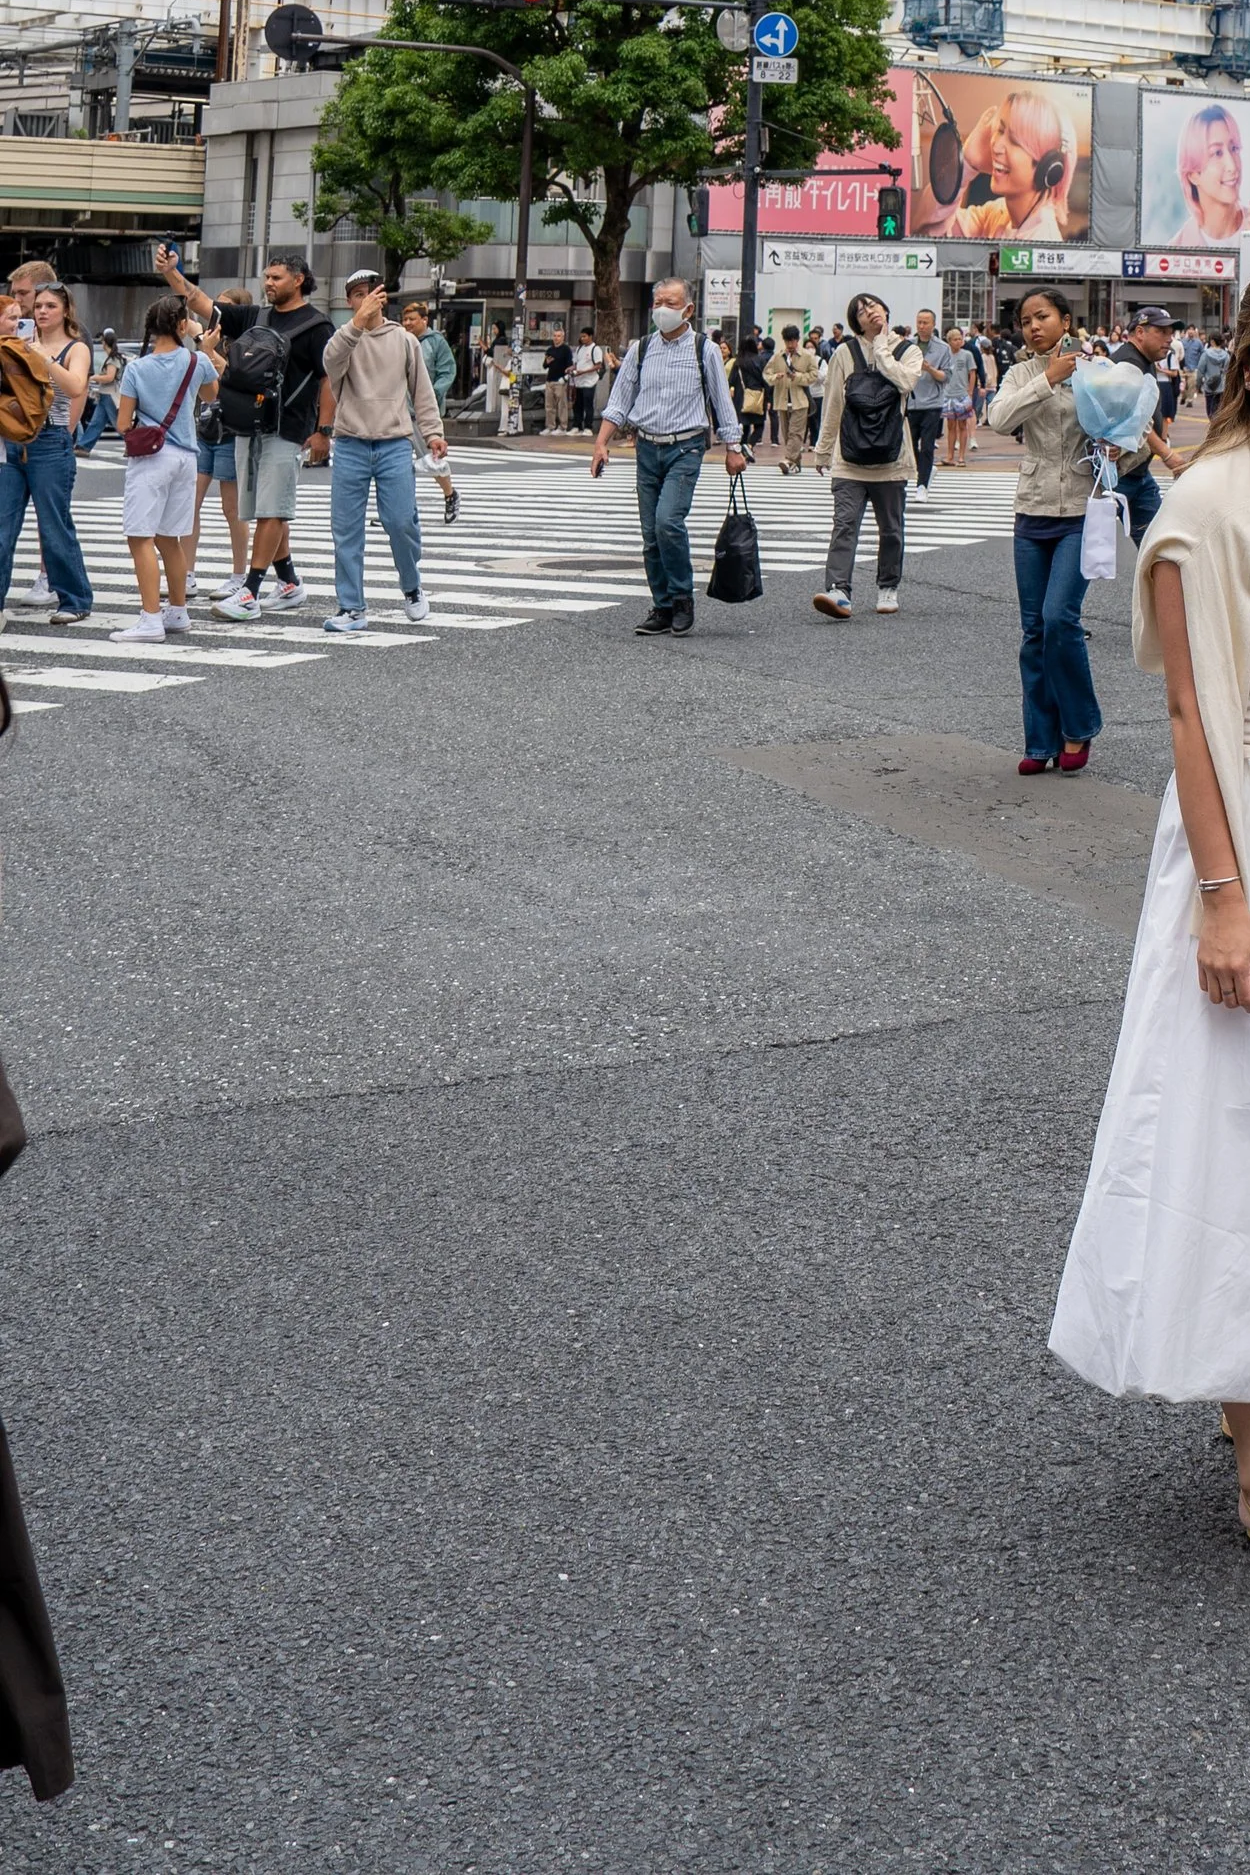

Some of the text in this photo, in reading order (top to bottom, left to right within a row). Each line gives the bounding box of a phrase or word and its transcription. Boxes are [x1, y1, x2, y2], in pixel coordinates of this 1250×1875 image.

[758, 180, 879, 212] 角散ダイレクト
[838, 252, 900, 264] 渋谷駅改札口方面
[1011, 251, 1030, 265] JR
[1037, 252, 1065, 264] 渋谷駅
